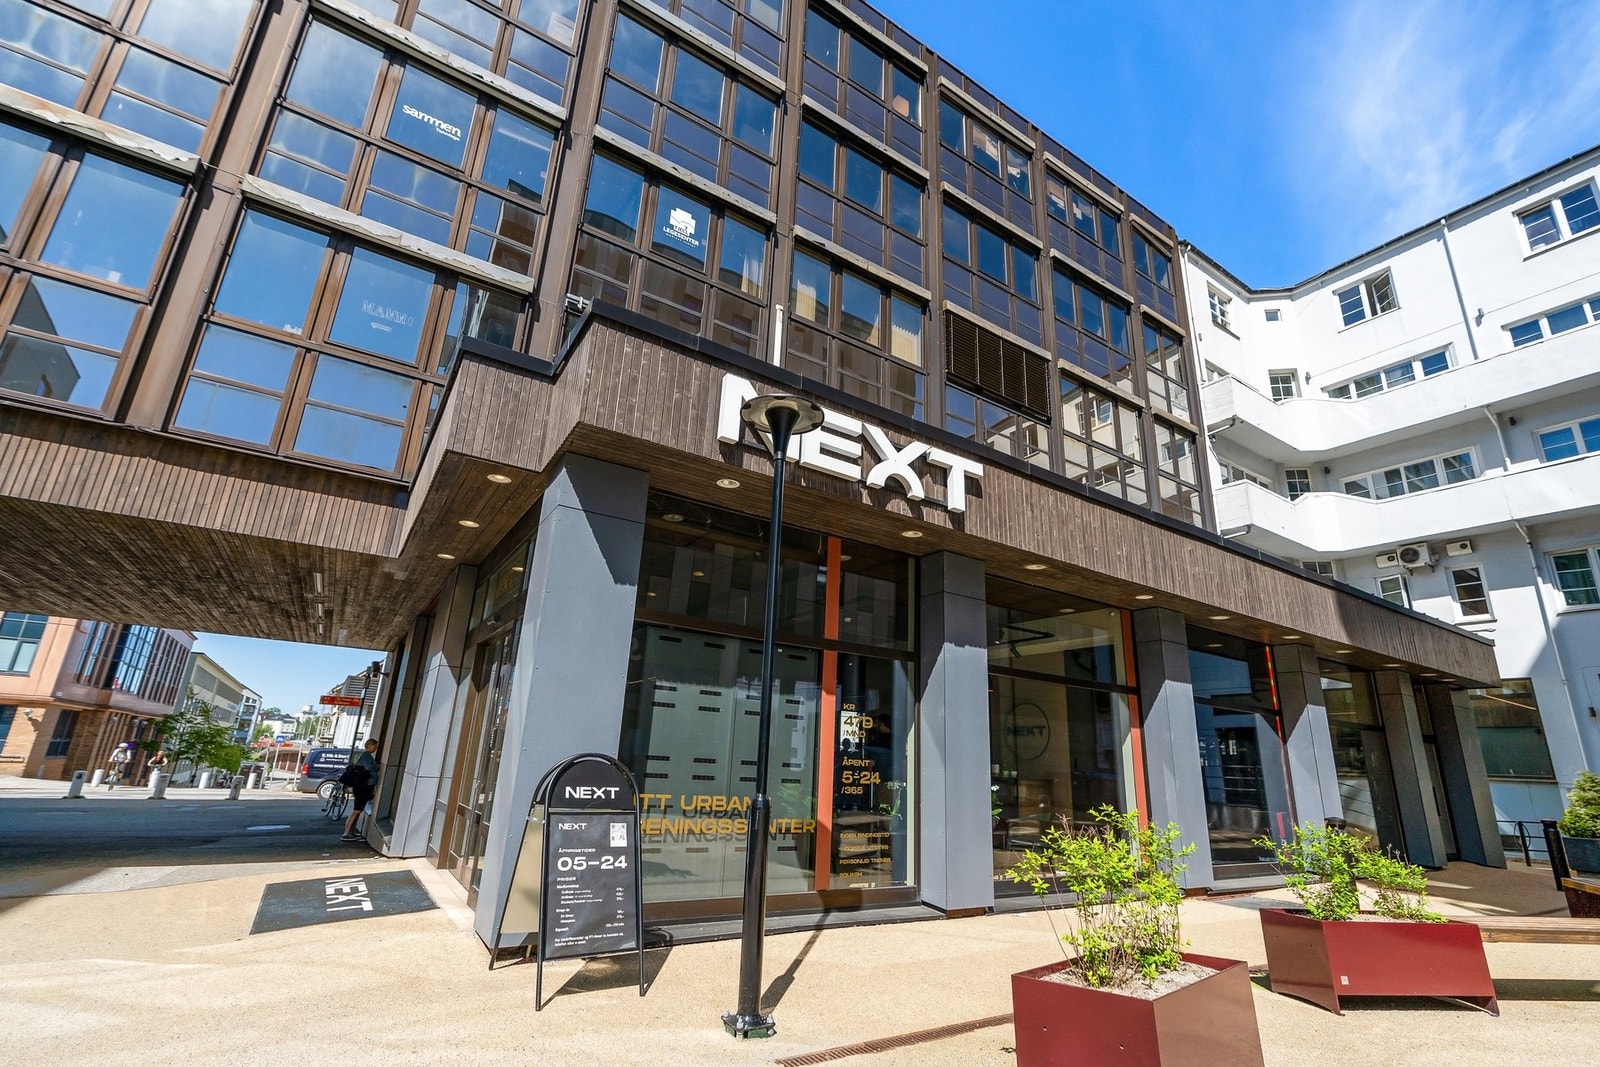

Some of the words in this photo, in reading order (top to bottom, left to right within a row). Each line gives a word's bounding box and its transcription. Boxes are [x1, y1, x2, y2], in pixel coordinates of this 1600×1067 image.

[402, 104, 462, 138] sammen
[663, 226, 699, 247] LEGESENTER
[717, 372, 985, 514] NEXT
[843, 703, 856, 711] KR
[843, 715, 874, 729] 479
[1007, 725, 1046, 737] NEXT
[842, 756, 871, 767] ÅPENT
[841, 770, 881, 785] 5-24
[564, 786, 620, 799] NEXT
[841, 786, 864, 794] /365
[558, 822, 588, 831] NEXT
[325, 877, 374, 912] NEXT
